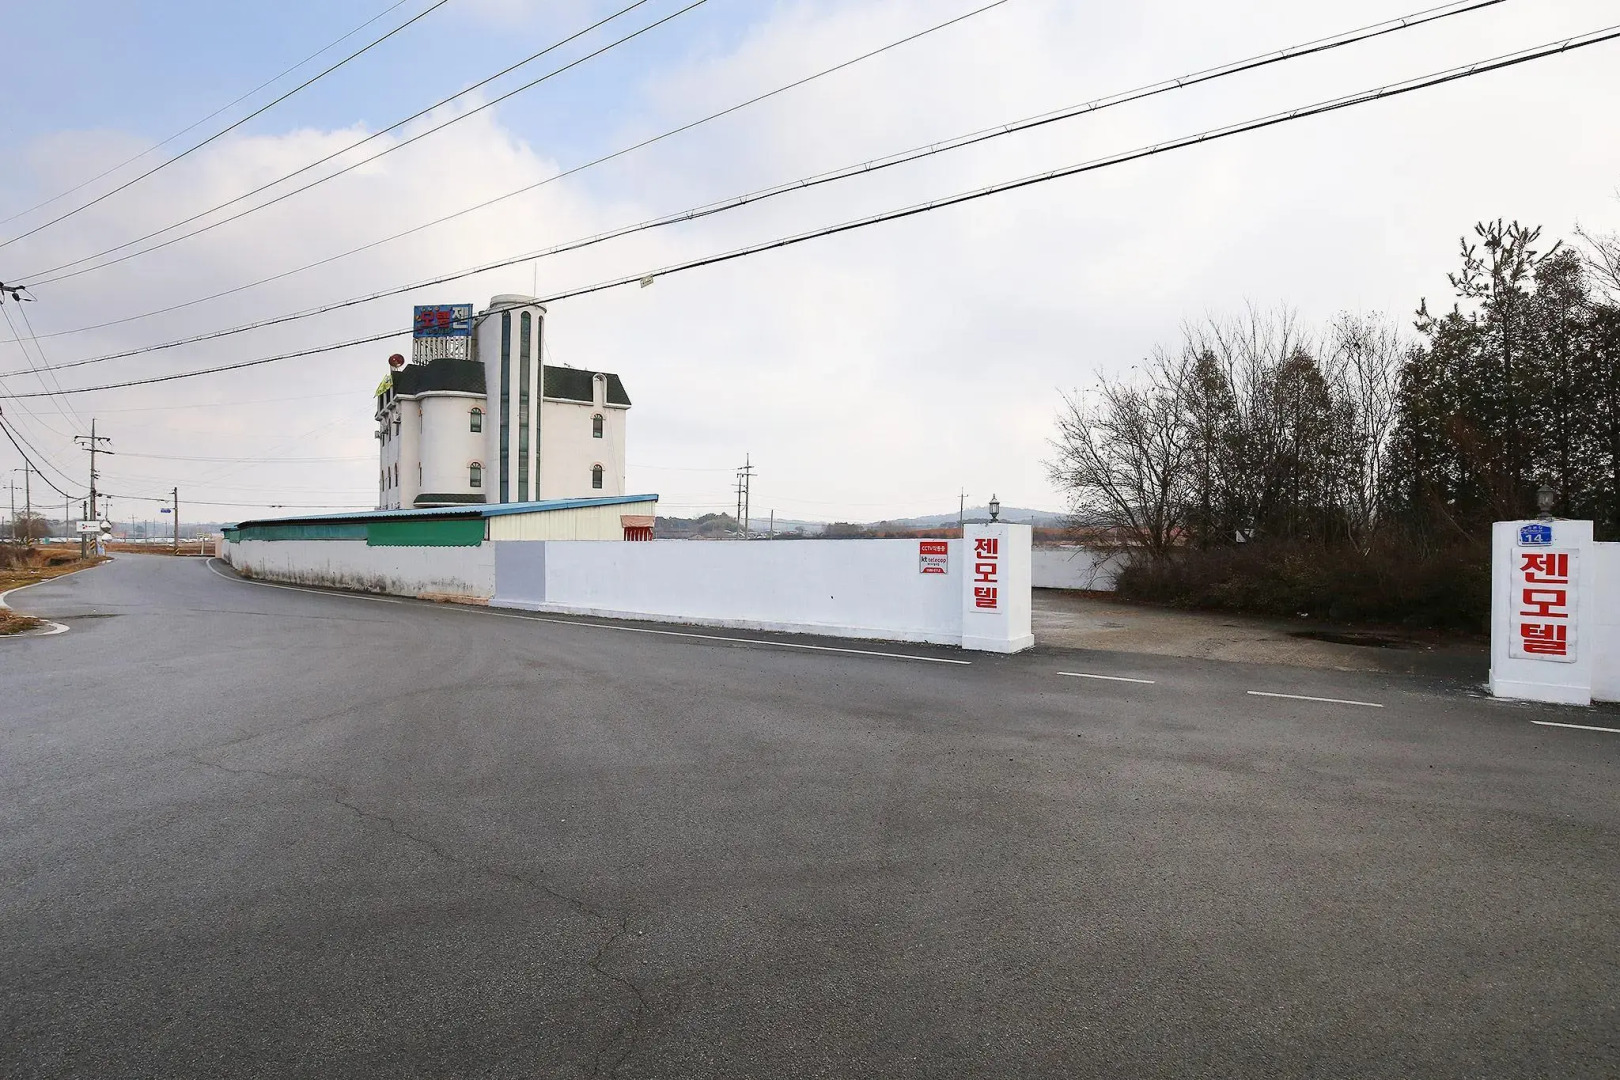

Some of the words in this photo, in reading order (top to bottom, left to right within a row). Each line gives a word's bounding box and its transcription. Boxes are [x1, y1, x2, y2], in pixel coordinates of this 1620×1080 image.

[973, 538, 998, 609] 젠모텔
[1525, 533, 1544, 543] 14
[1519, 553, 1569, 656] 젠모텔
